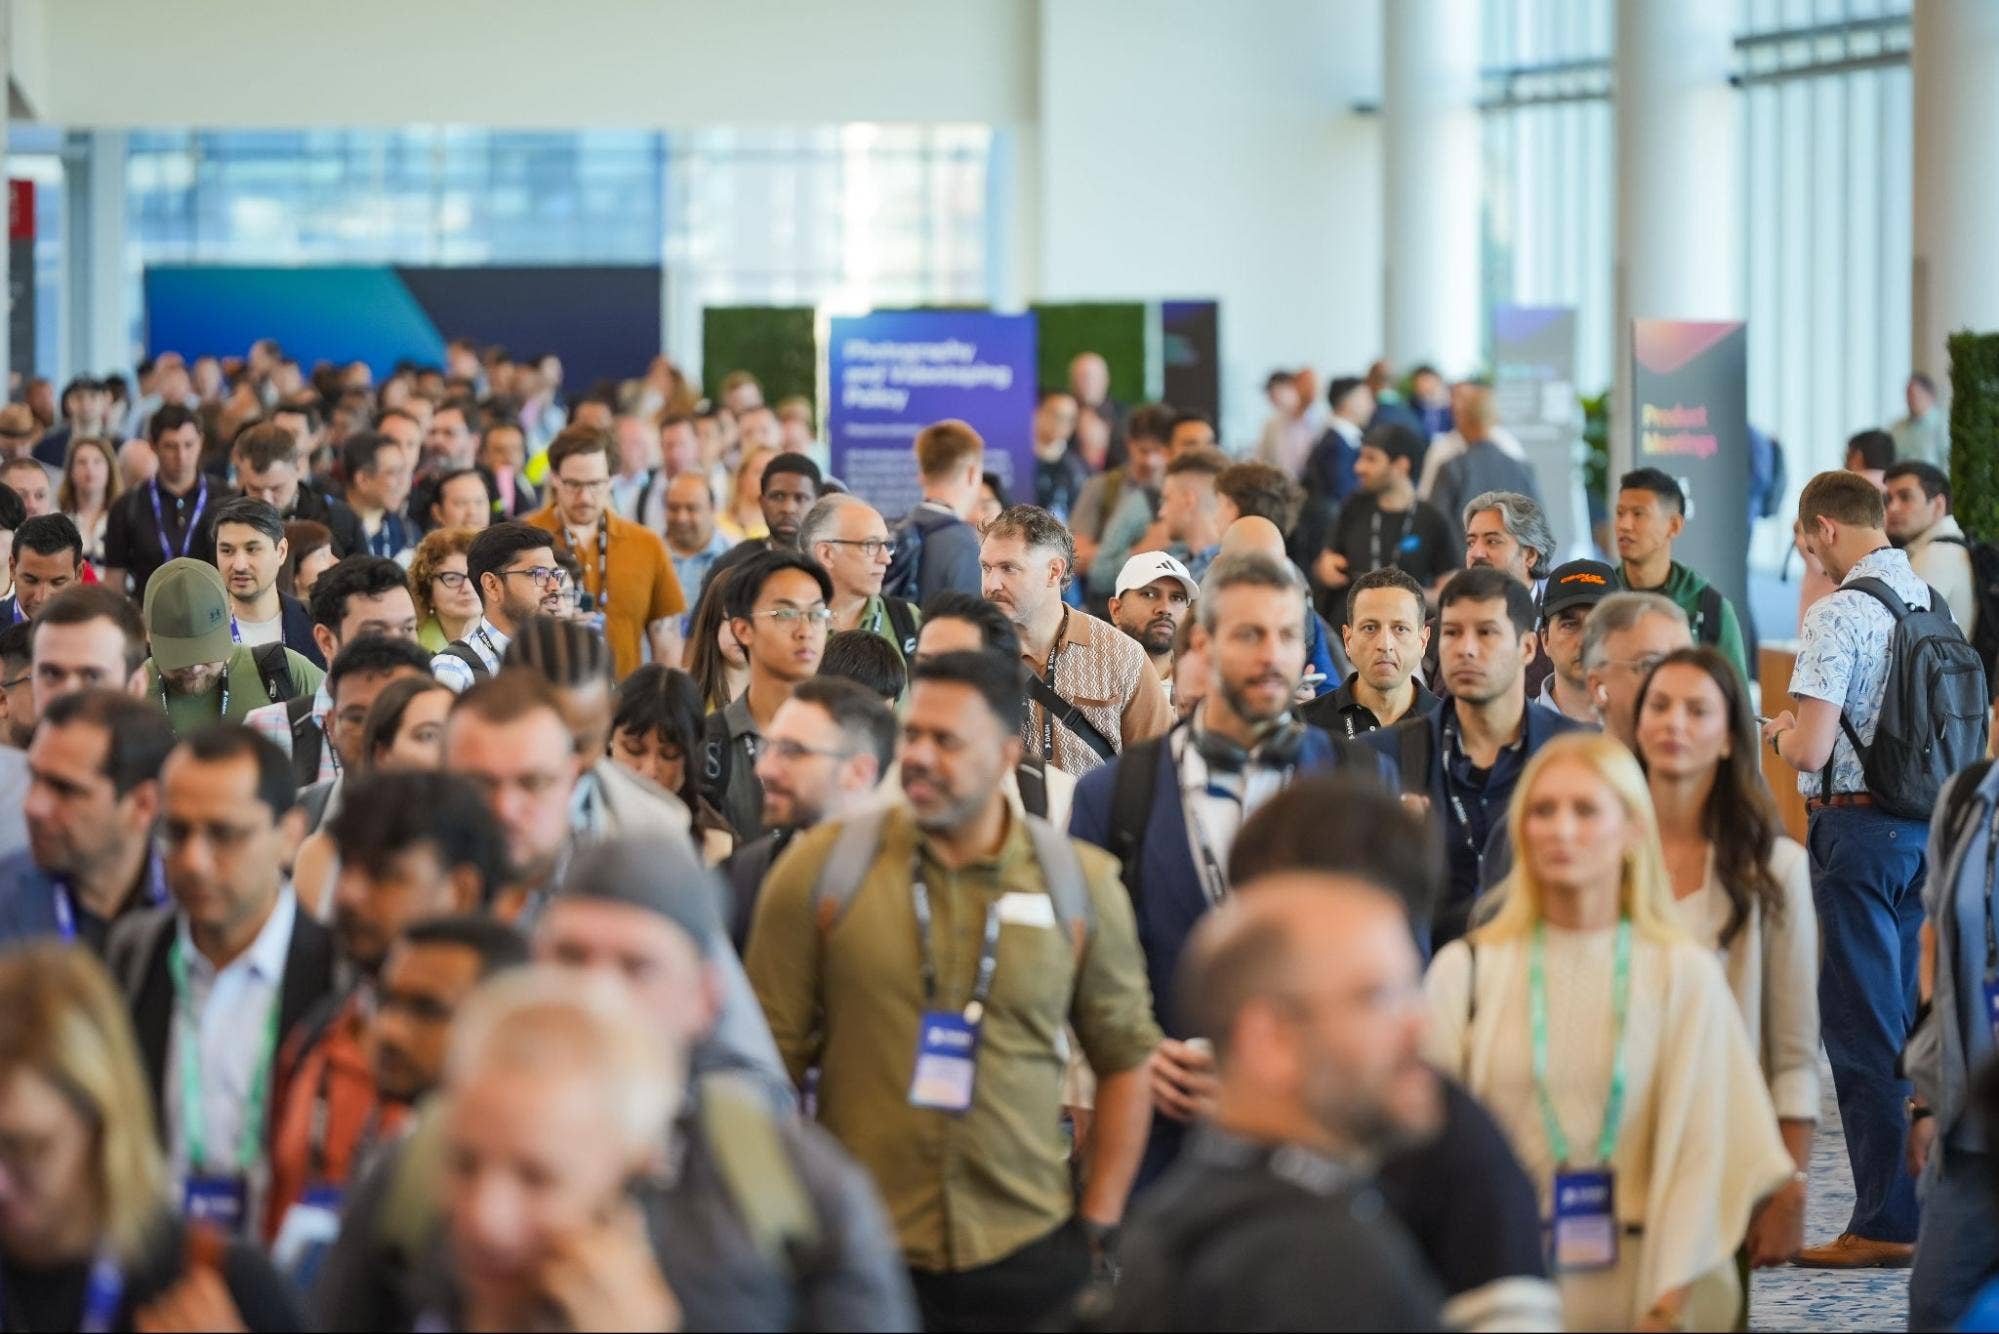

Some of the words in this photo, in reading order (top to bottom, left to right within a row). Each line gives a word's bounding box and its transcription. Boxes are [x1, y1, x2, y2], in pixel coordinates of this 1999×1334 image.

[844, 338, 976, 364] Photography
[843, 366, 887, 384] and
[843, 387, 910, 412] Policy
[1642, 402, 1708, 428] Product
[1642, 431, 1718, 459] Meetings
